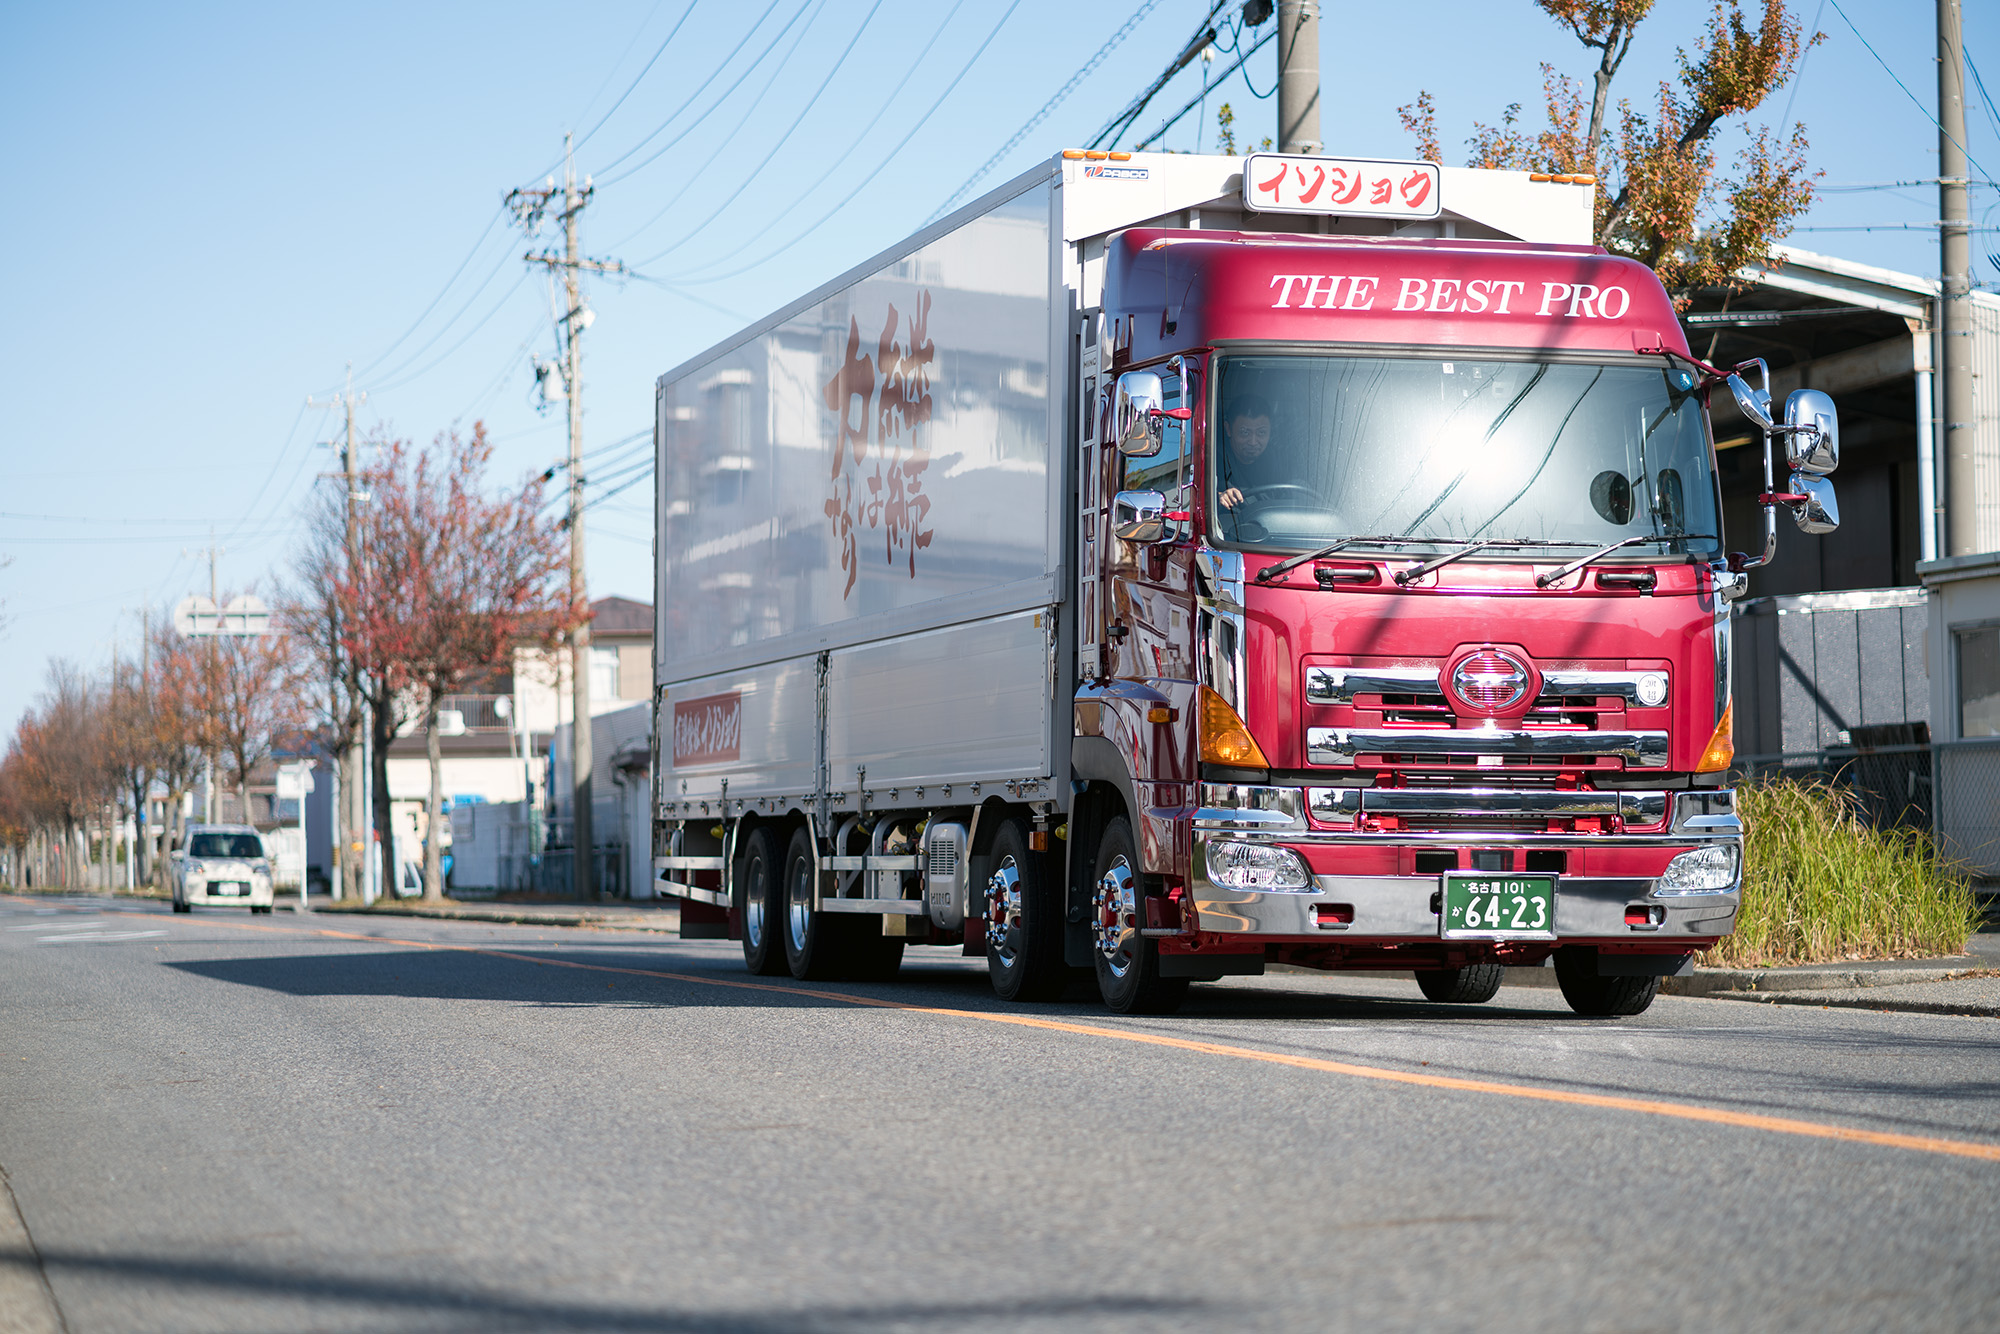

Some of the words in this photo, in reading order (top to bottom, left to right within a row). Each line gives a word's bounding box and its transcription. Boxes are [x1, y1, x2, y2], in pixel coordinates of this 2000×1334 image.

[1258, 162, 1432, 208] イソショウ
[1269, 274, 1379, 311] THE
[1392, 278, 1525, 314] BEST
[1535, 282, 1631, 319] PRO
[930, 892, 952, 906] HINO
[1467, 882, 1501, 894] 名古屋
[1504, 882, 1525, 894] 101
[1451, 905, 1463, 917] か
[1465, 895, 1547, 928] 64-23
